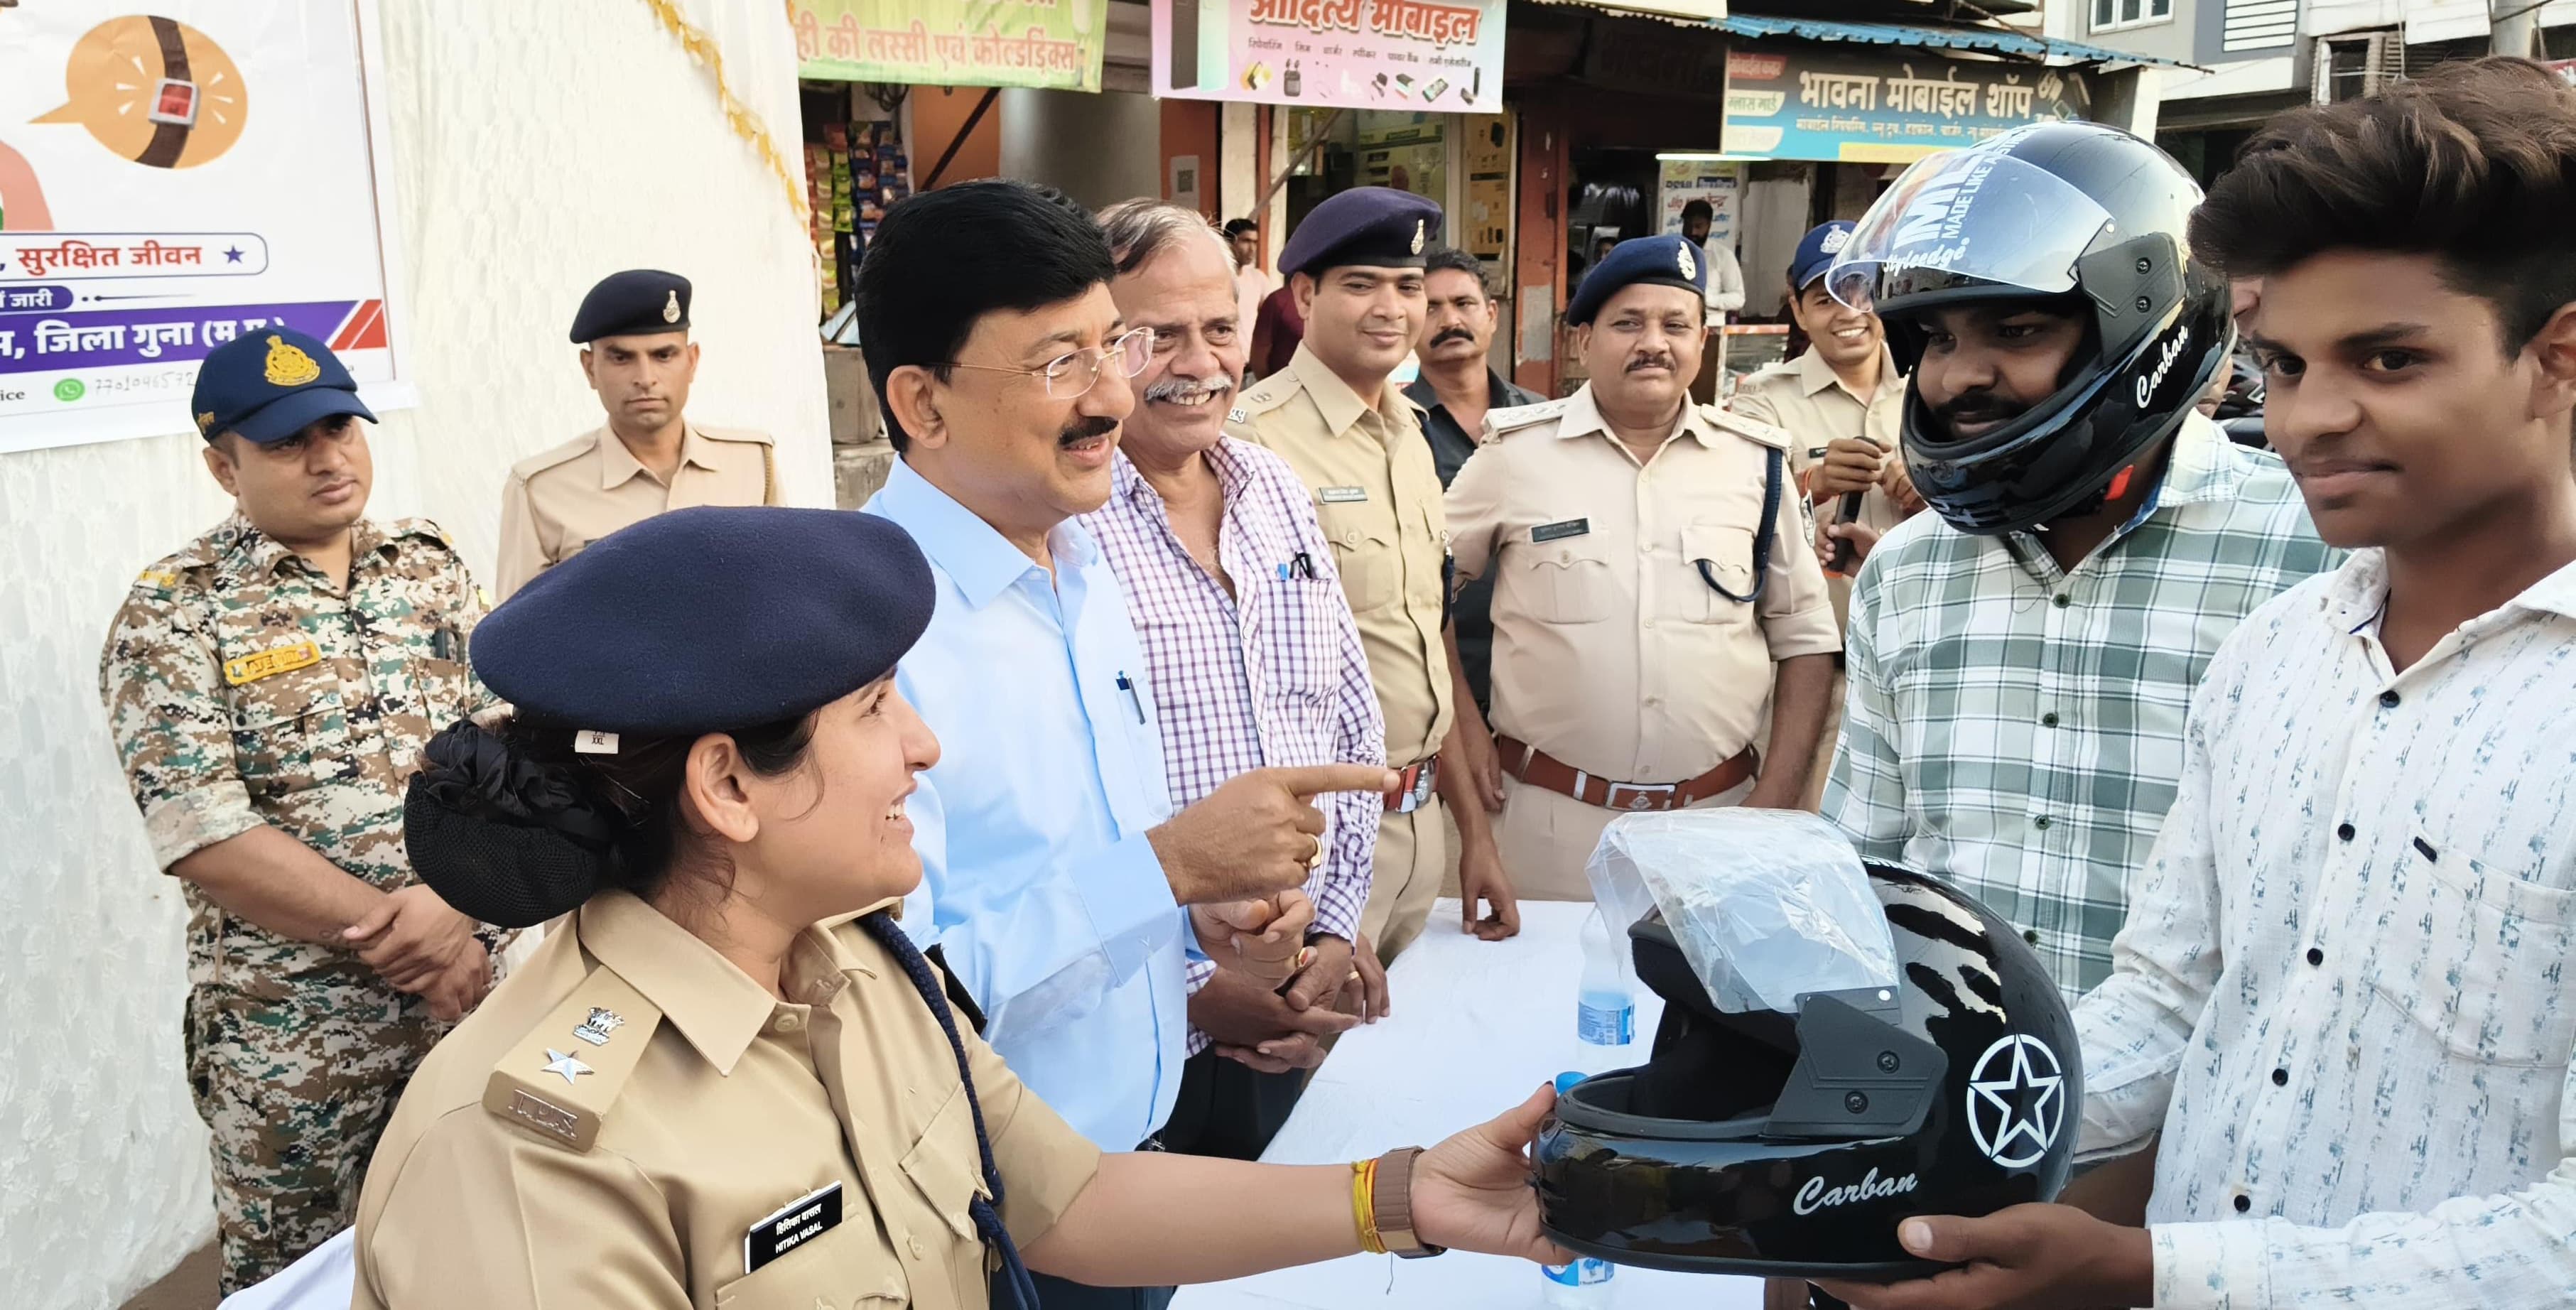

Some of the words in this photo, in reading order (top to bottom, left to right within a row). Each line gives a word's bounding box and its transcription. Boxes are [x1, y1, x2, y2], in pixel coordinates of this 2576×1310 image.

[795, 10, 819, 62] ही
[826, 13, 860, 60] की
[865, 18, 928, 64] लस्सी
[933, 22, 967, 71] एवं
[1799, 71, 1879, 111] भावना
[1887, 63, 1979, 119] मोबाईल
[1986, 74, 2035, 119] शॉप
[1942, 190, 1974, 238] MADE
[1961, 166, 1993, 193] LIKE
[16, 240, 121, 276] सुरक्षित
[129, 239, 202, 266] जीवन
[9, 288, 54, 307] जारी
[33, 319, 126, 355] जिला
[131, 322, 195, 357] गुना
[2137, 325, 2188, 408] Carban
[1793, 1166, 1918, 1215] Carban
[775, 1233, 799, 1254] HITIKA
[799, 1220, 823, 1240] VASAL
